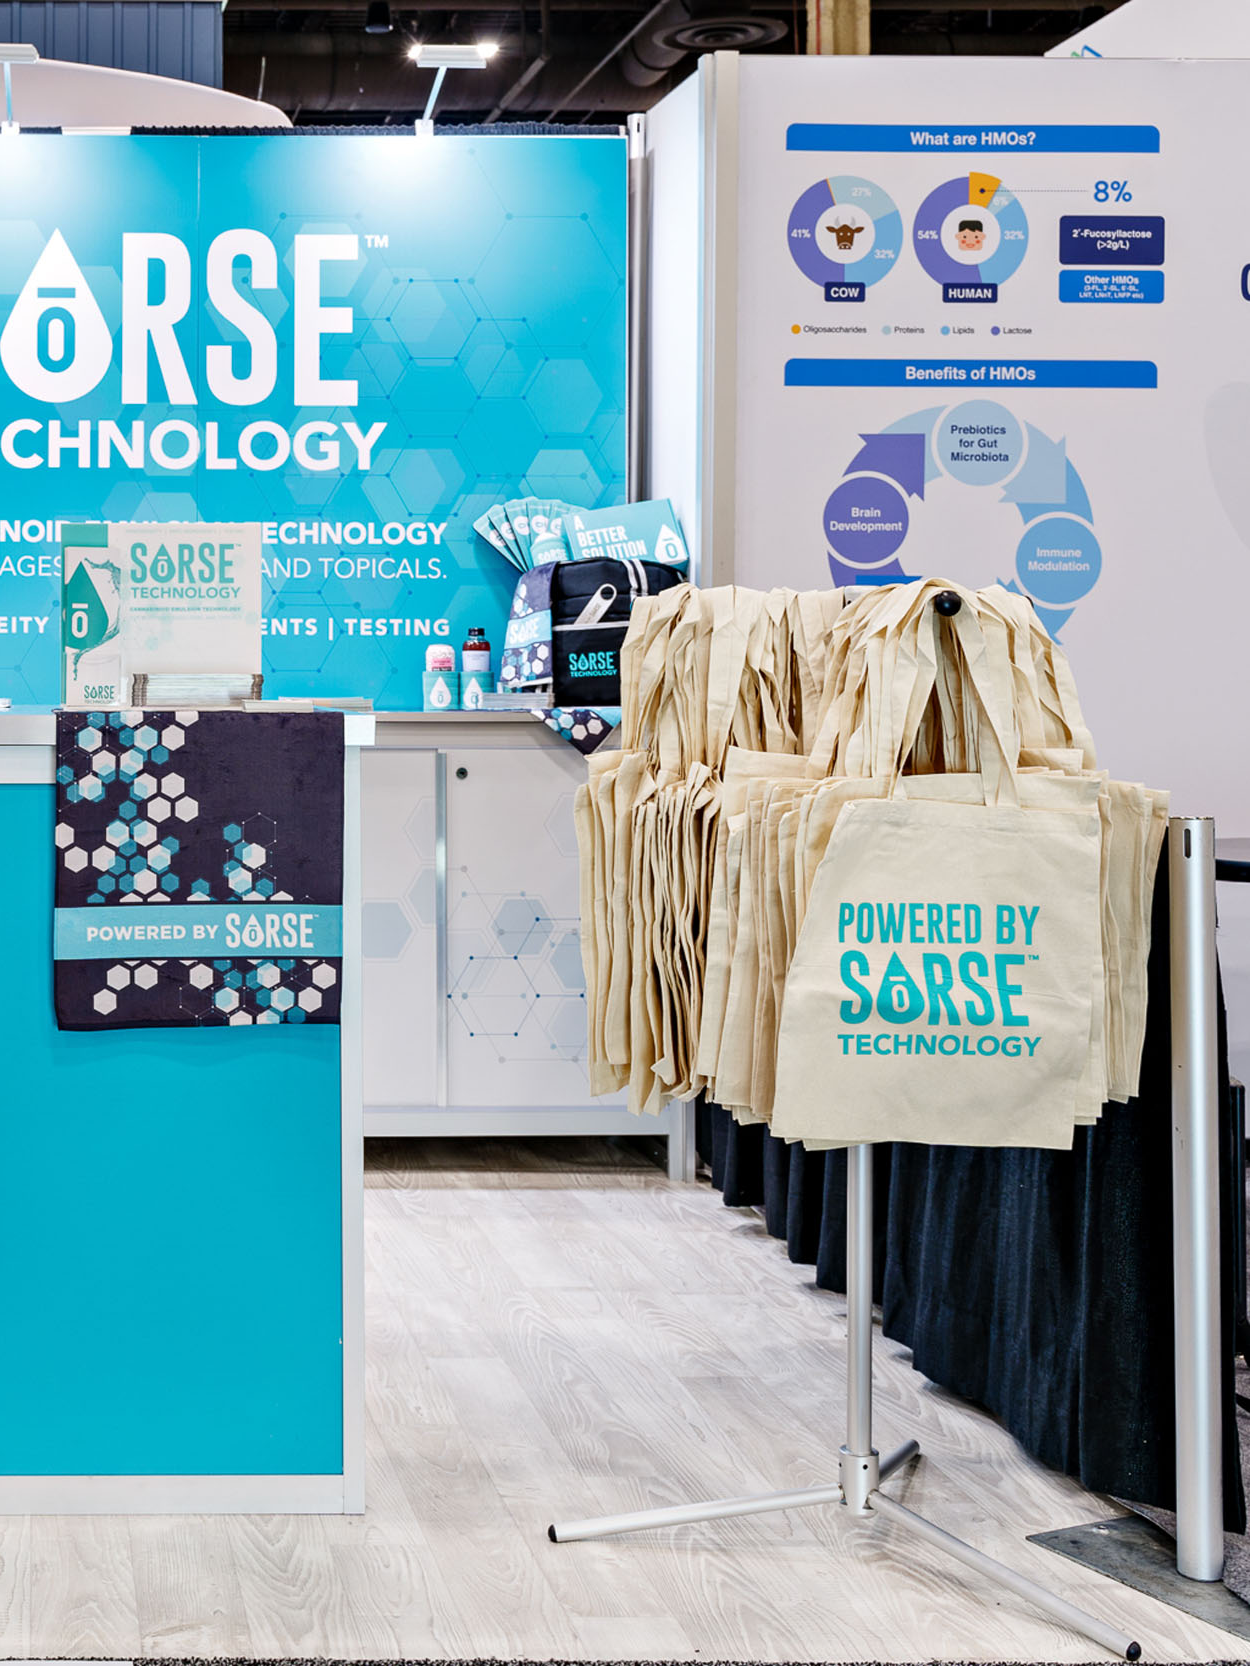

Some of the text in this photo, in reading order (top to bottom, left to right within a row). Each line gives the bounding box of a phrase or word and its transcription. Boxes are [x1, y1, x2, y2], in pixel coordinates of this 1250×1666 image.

[910, 131, 1036, 146] What are HMOs?
[1094, 180, 1132, 203] 8%
[791, 229, 811, 239] 41%
[917, 230, 939, 240] 54%
[1004, 230, 1025, 240] 32%
[874, 249, 895, 259] 32%
[830, 287, 859, 298] COW
[948, 288, 992, 299] HUMAN
[803, 325, 867, 335] Oligosaccharides
[894, 326, 925, 335] Proteins
[952, 326, 974, 336] Lipids
[1003, 326, 1032, 335] Lactose
[905, 366, 1036, 380] Benefits of HMOs
[950, 425, 1006, 435] Prebiotics
[959, 438, 998, 448] for Gut
[950, 452, 1009, 462] Microbiota
[851, 507, 881, 518] Brain
[573, 515, 584, 530] A
[829, 521, 902, 534] Development
[261, 522, 448, 545] ECHNOLOGY
[576, 525, 628, 547] BETTER
[1036, 547, 1082, 558] Immune
[318, 557, 448, 579] TOPICALS.
[1028, 560, 1090, 572] Modulation
[131, 586, 241, 599] TECHNOLOGY
[344, 618, 450, 636] TESTING
[570, 669, 617, 678] TECHNOLOGY
[838, 902, 1040, 946] POWERED BY
[86, 925, 186, 942] POWERED
[193, 924, 218, 940] BY
[837, 1034, 1042, 1057] TECHNOLOGY
